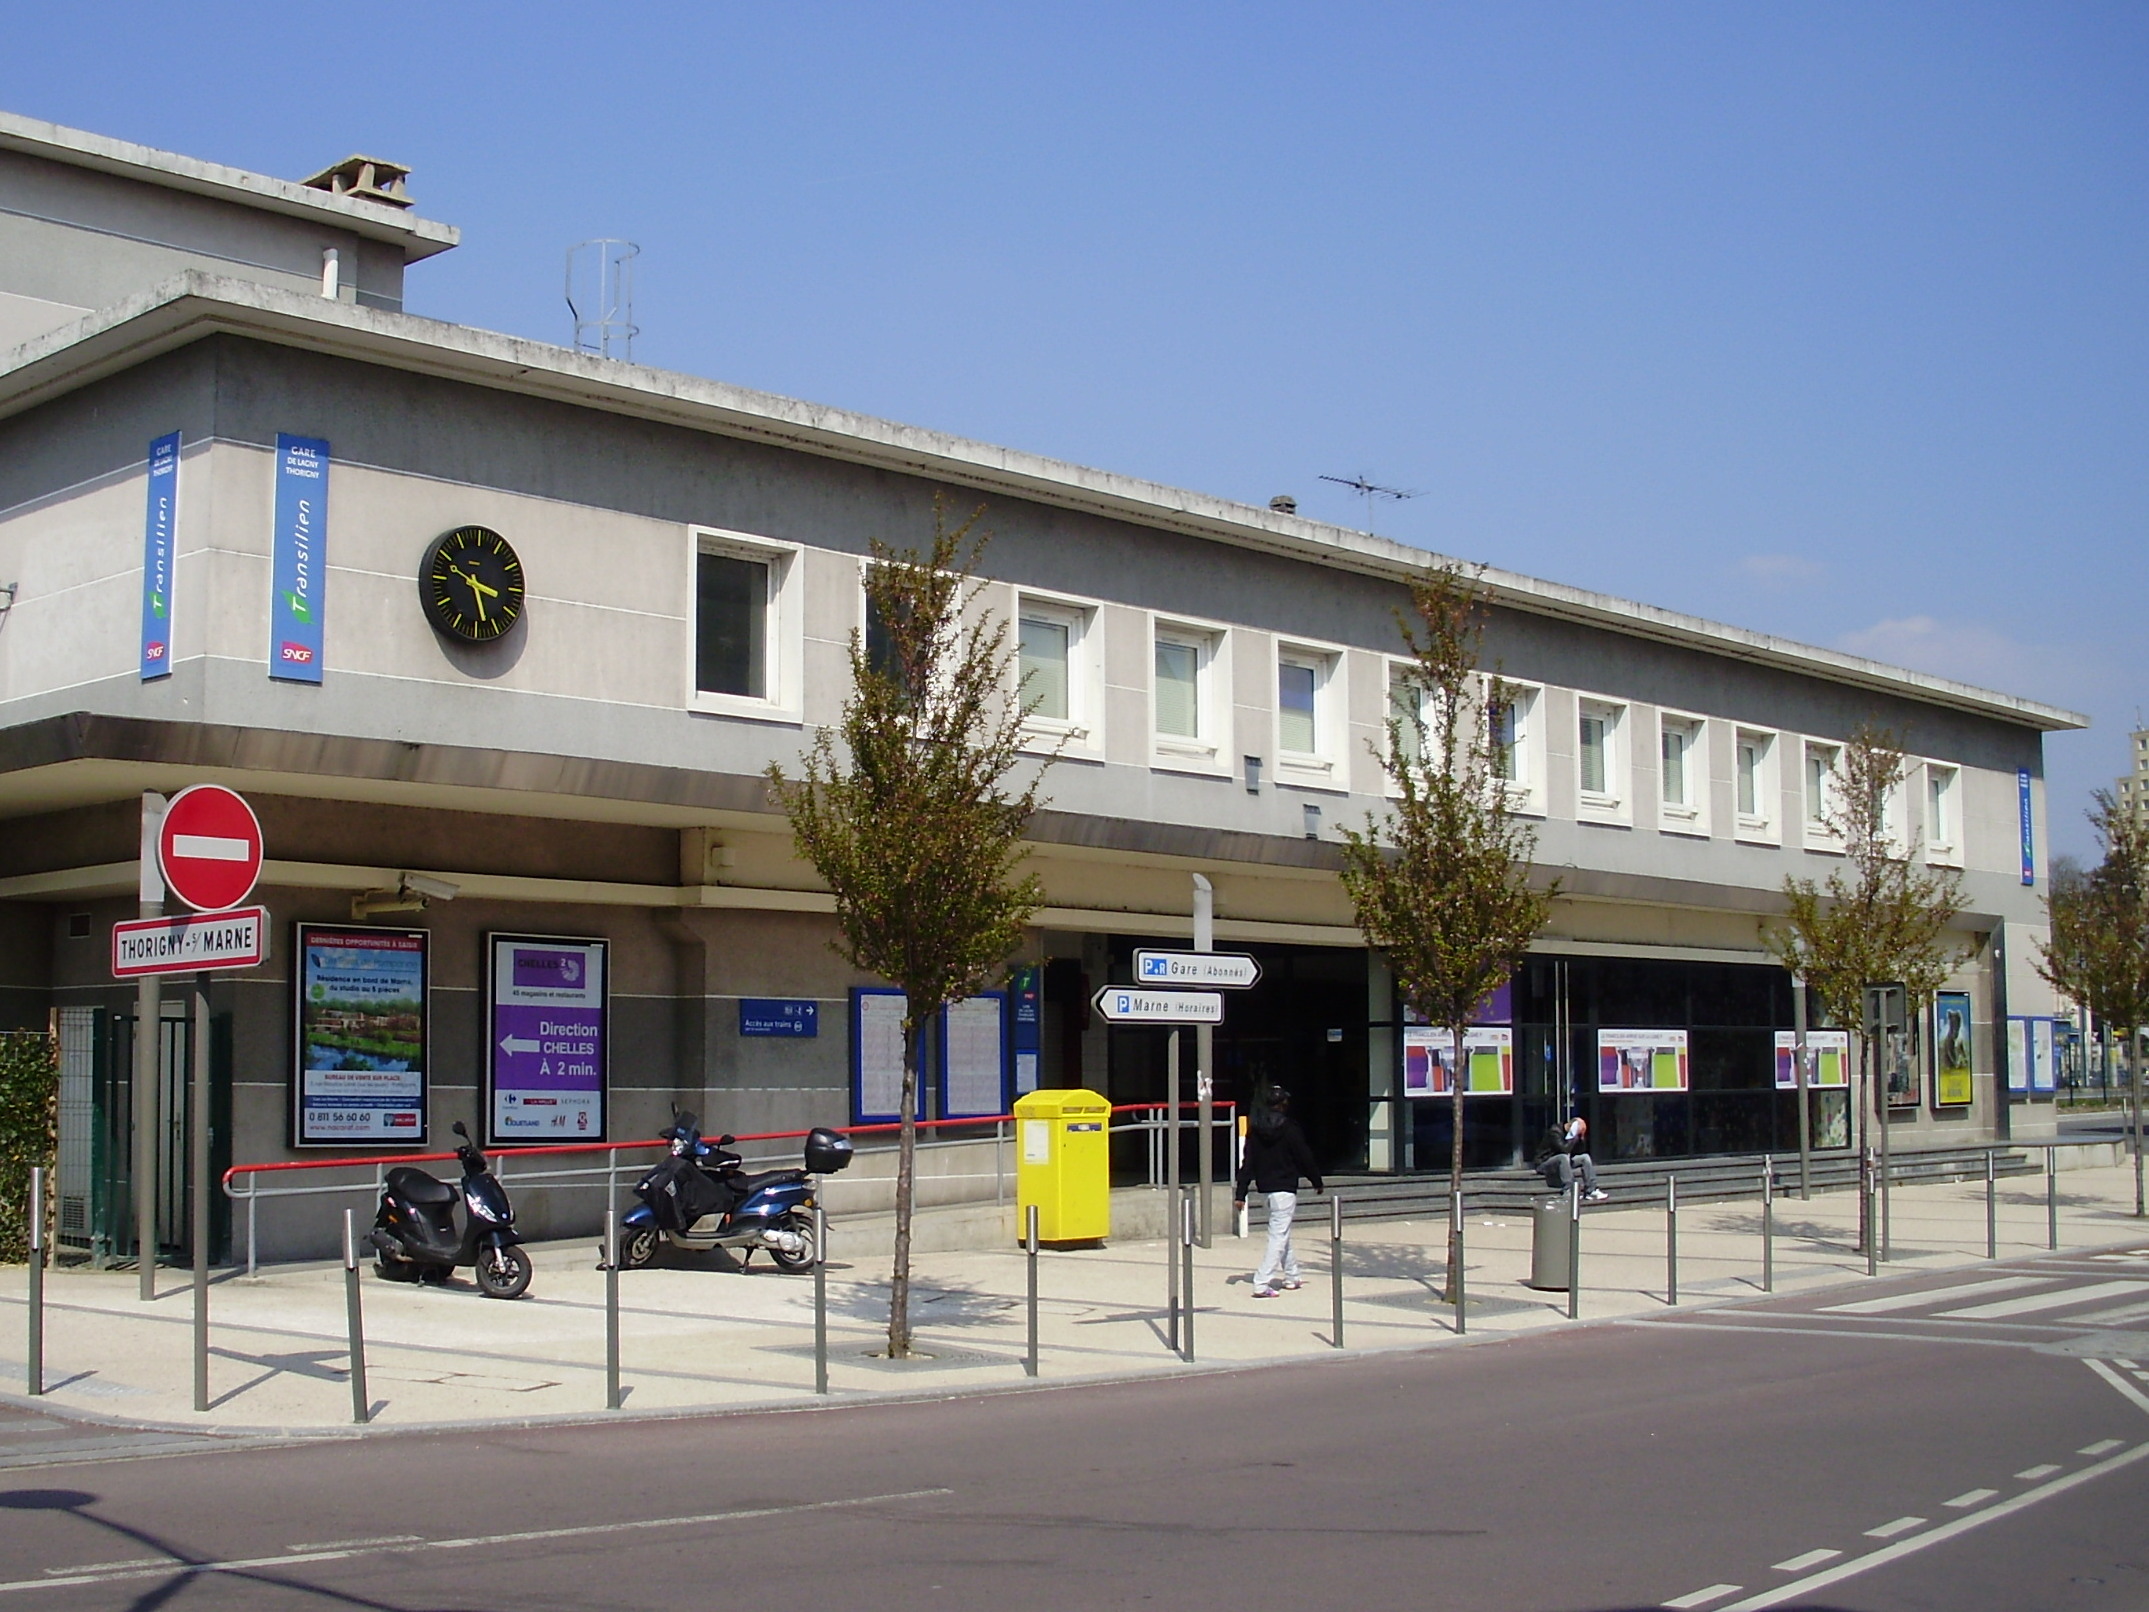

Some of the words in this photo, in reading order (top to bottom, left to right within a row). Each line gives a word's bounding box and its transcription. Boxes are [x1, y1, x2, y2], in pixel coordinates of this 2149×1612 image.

[291, 446, 317, 458] GARE
[287, 457, 296, 465] DE
[297, 459, 319, 468] LAGNY
[285, 466, 320, 479] THORIGNY
[152, 497, 168, 610] Transilien
[292, 499, 311, 612] Transilien
[146, 646, 164, 660] SNCF
[282, 648, 312, 661] SNCF
[518, 959, 559, 969] CHELLES
[560, 958, 566, 967] 2
[1171, 961, 1198, 975] Gare
[316, 974, 350, 983] Résidence
[363, 976, 379, 984] bord
[556, 991, 586, 999] restaurants
[1119, 997, 1128, 1012] P
[1133, 999, 1169, 1012] Marne
[539, 1021, 598, 1037] Direction
[745, 1019, 762, 1027] Accès
[774, 1020, 792, 1028] trains
[543, 1041, 595, 1055] CHELLES
[539, 1057, 551, 1075] À
[557, 1061, 565, 1075] 2
[568, 1061, 597, 1076] min.
[309, 1112, 314, 1121] 0
[317, 1112, 329, 1121] 811
[332, 1112, 344, 1121] 56
[346, 1112, 357, 1121] 60
[359, 1112, 371, 1121] 60
